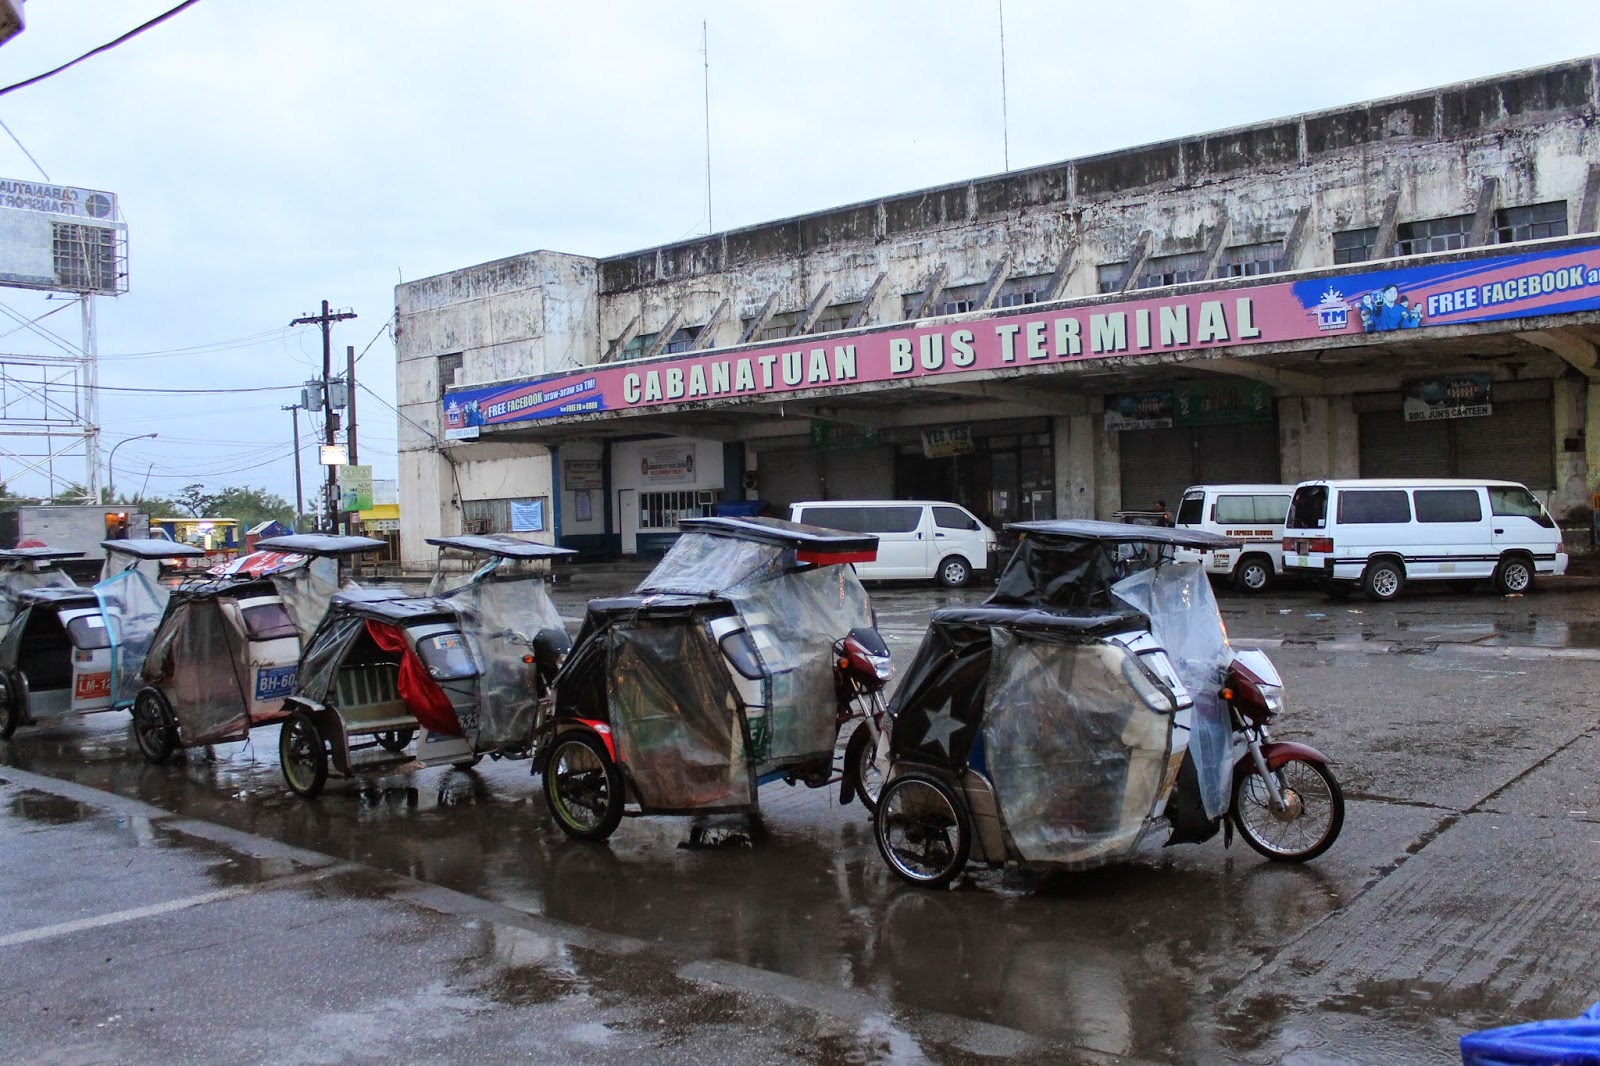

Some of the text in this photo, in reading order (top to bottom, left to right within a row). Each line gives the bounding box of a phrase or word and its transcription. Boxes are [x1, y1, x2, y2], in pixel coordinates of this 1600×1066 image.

[1427, 287, 1477, 315] FREE
[1482, 266, 1584, 305] FACEBOOK
[1321, 310, 1345, 323] TM
[623, 297, 1260, 404] CABANATUAN BUS TERMINAL
[488, 401, 507, 418] FREE
[507, 391, 543, 413] FACEBOOK
[543, 385, 576, 402] araw-araw
[575, 383, 583, 393] sa
[449, 412, 459, 421] TM
[1408, 406, 1488, 420] BRO. JUN'S CANTEEN
